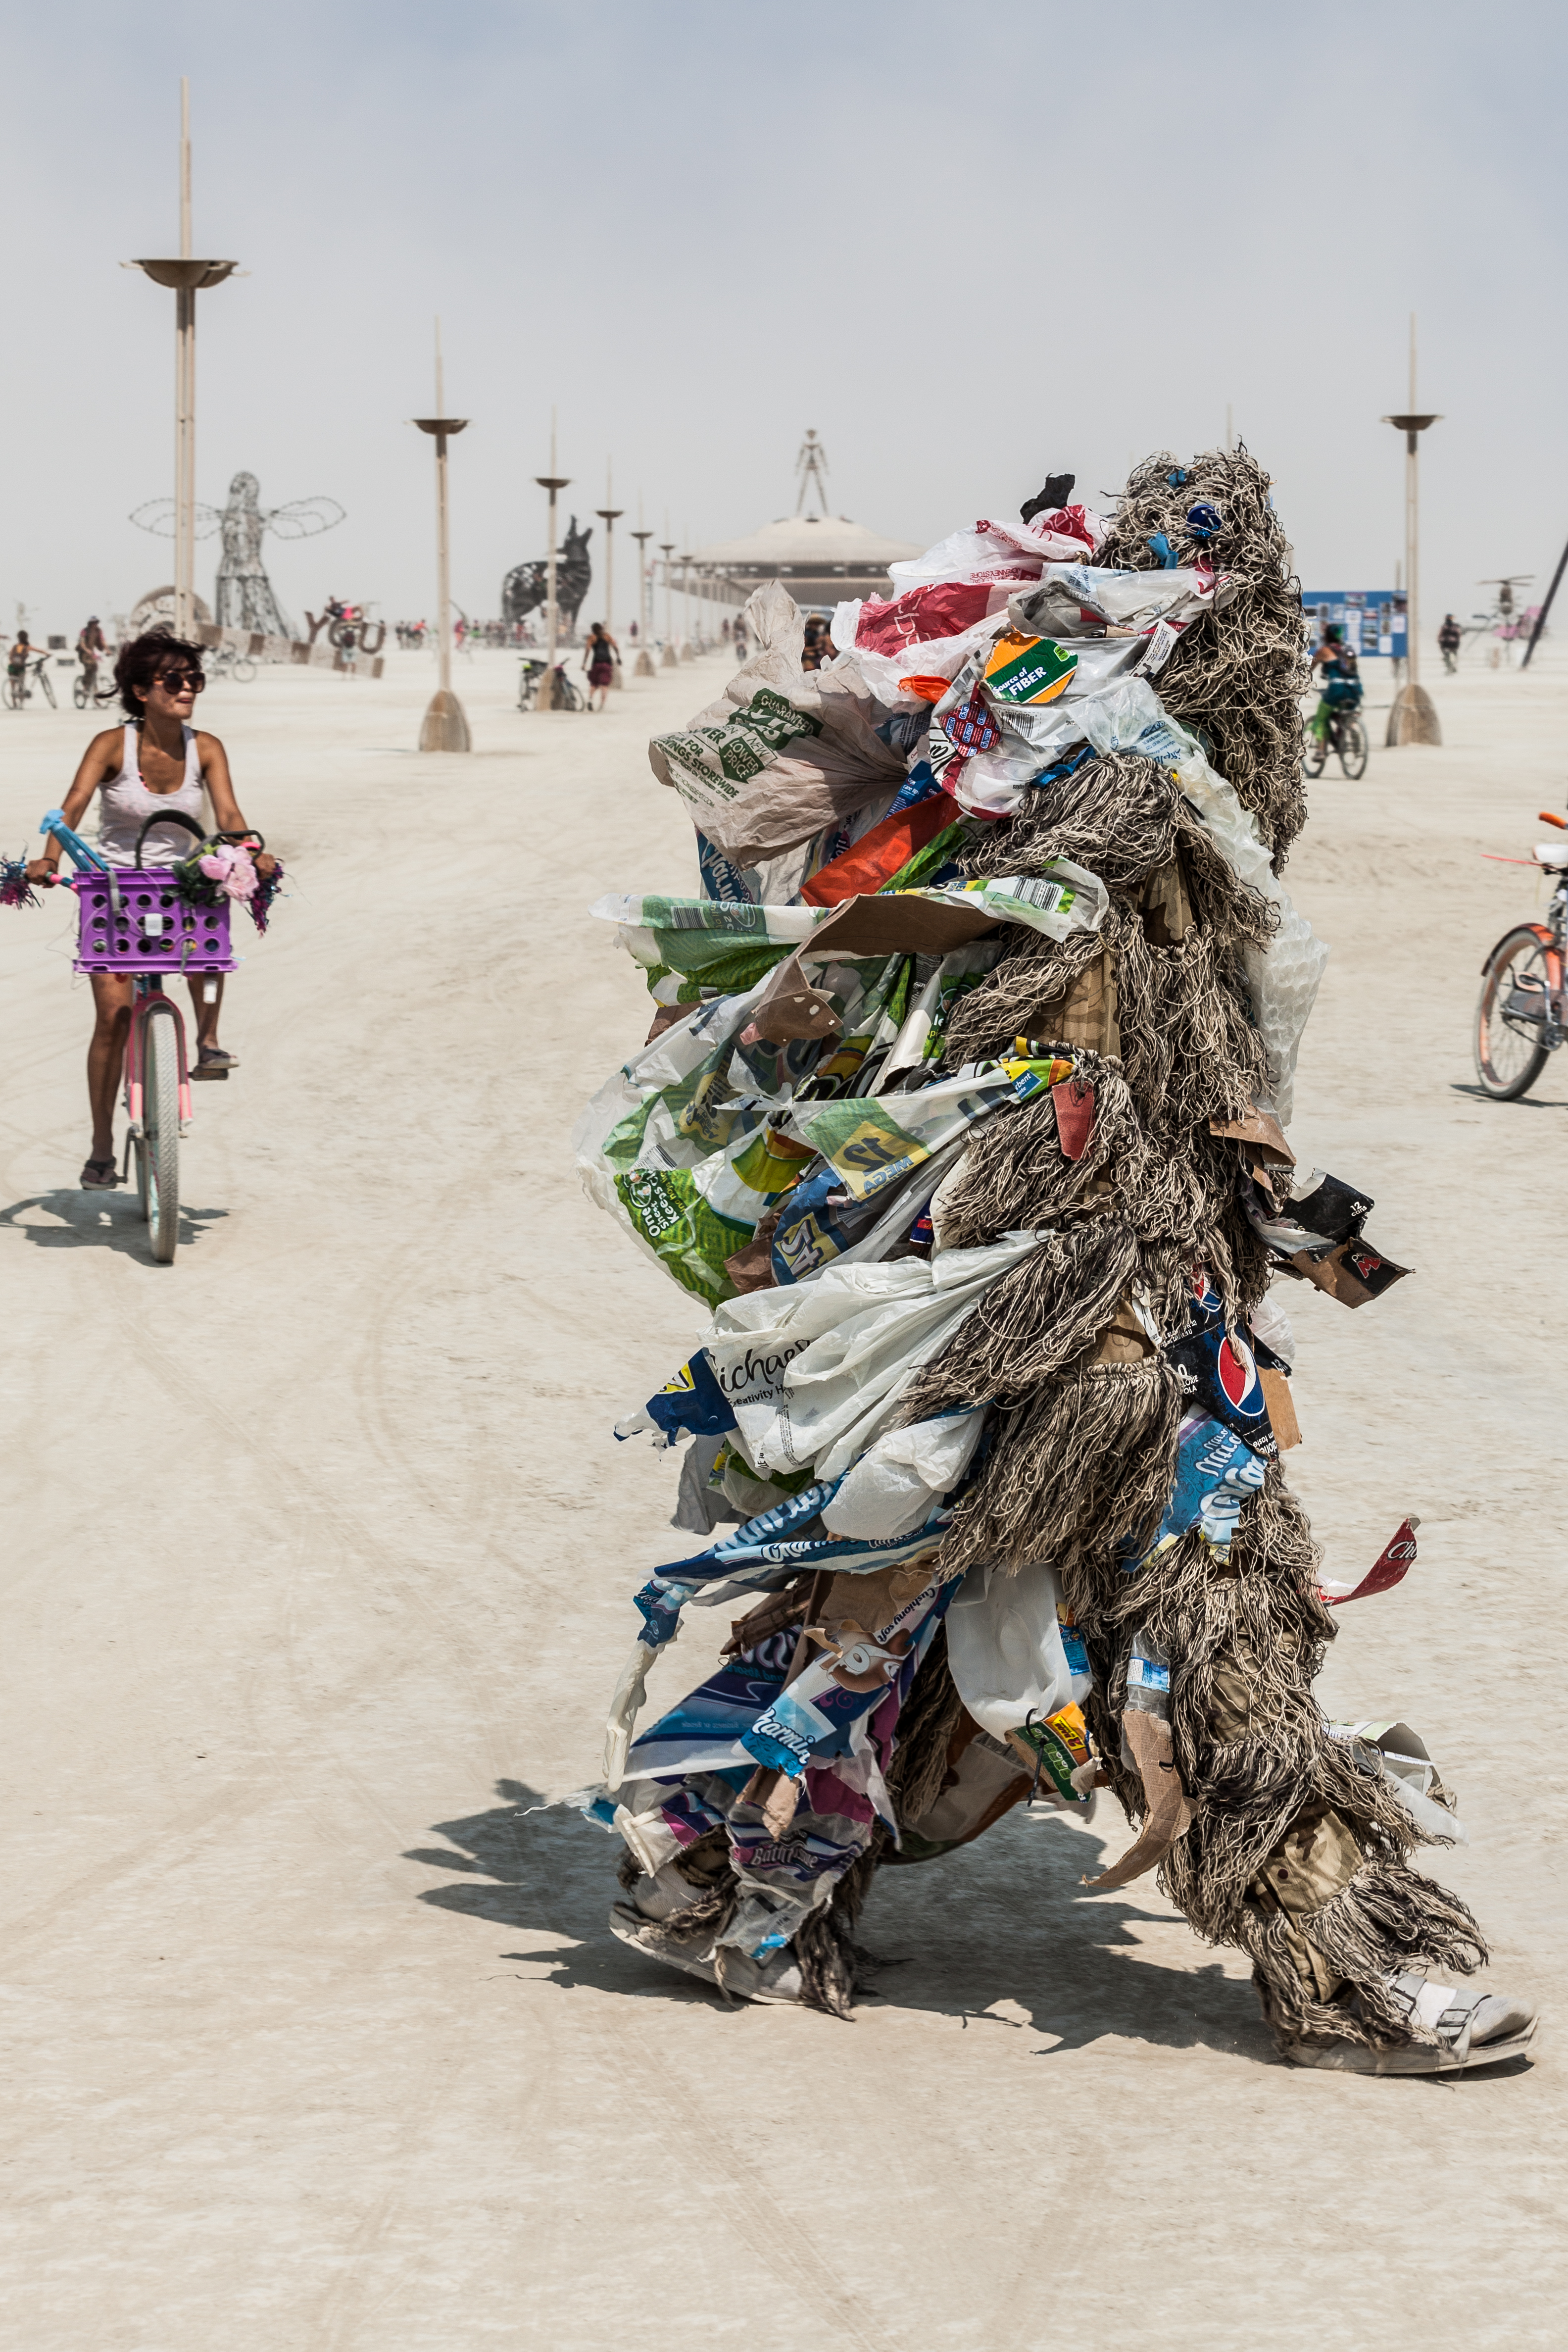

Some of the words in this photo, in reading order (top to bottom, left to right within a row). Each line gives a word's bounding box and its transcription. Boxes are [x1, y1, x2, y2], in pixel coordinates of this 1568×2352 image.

[992, 675, 1018, 694] Source
[1019, 666, 1028, 678] of
[1009, 666, 1047, 696] FIBER
[761, 695, 814, 735] GUARANTEED
[946, 718, 955, 737] durex
[963, 723, 973, 742] durex
[980, 729, 991, 748] durex
[685, 740, 704, 757] FOR
[729, 739, 759, 774] LOWER
[746, 735, 770, 757] NEW
[725, 751, 750, 780] PRICE
[693, 758, 739, 799] STOREWIDE
[654, 1186, 680, 1224] Keeps
[1350, 1201, 1362, 1211] 12
[1351, 1205, 1368, 1216] cans
[642, 1206, 661, 1237] One
[1183, 1386, 1197, 1395] OLA
[1253, 1435, 1269, 1448] taste
[893, 1587, 935, 1625] Cushiony
[878, 1623, 894, 1643] soft
[752, 1707, 816, 1765] harmin
[1067, 1737, 1084, 1748] 2
